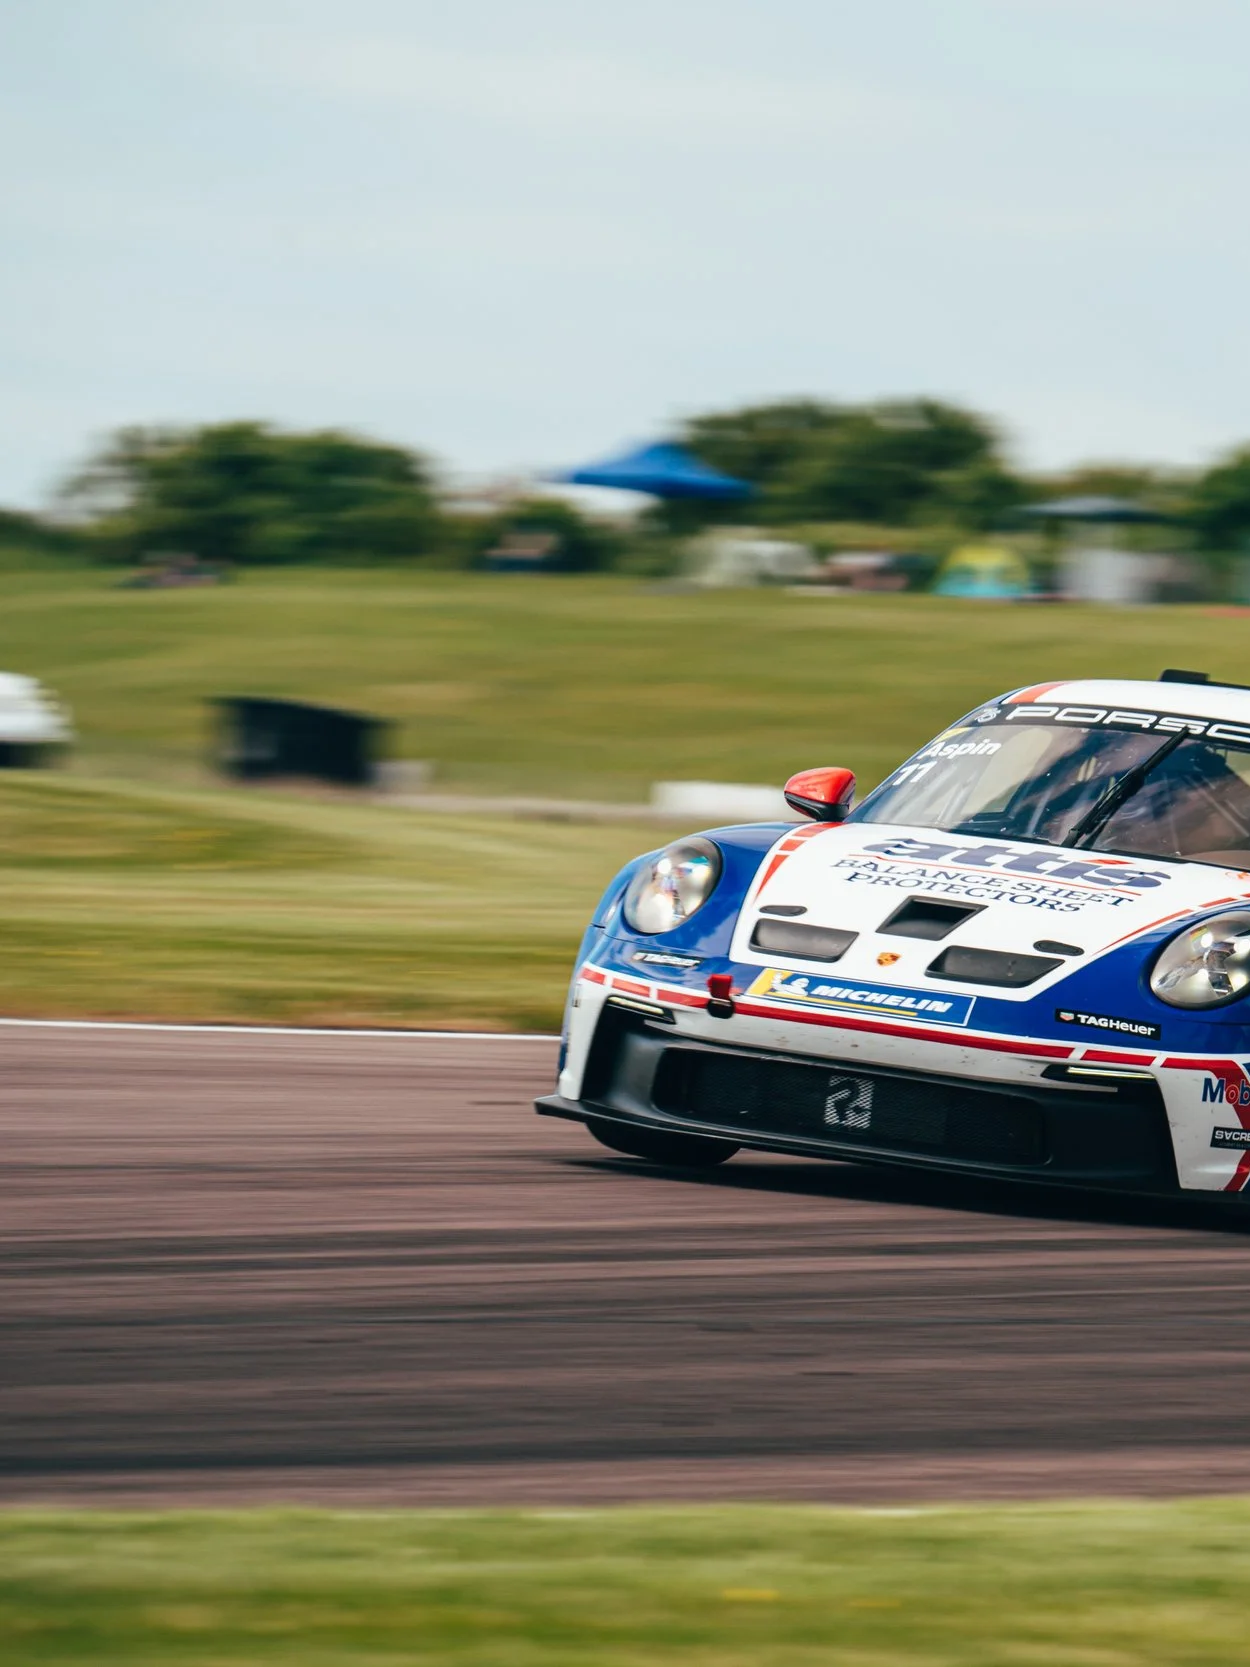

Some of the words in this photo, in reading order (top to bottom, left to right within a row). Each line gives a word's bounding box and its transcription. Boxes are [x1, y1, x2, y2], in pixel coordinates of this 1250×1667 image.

[917, 738, 1001, 760] Aspin
[892, 760, 938, 786] 11
[862, 838, 1171, 889] attis
[830, 858, 1013, 889] BALANCE
[1010, 877, 1134, 908] SHEET
[844, 871, 1085, 913] PROTECTORS
[811, 984, 954, 1013] MICHELIN
